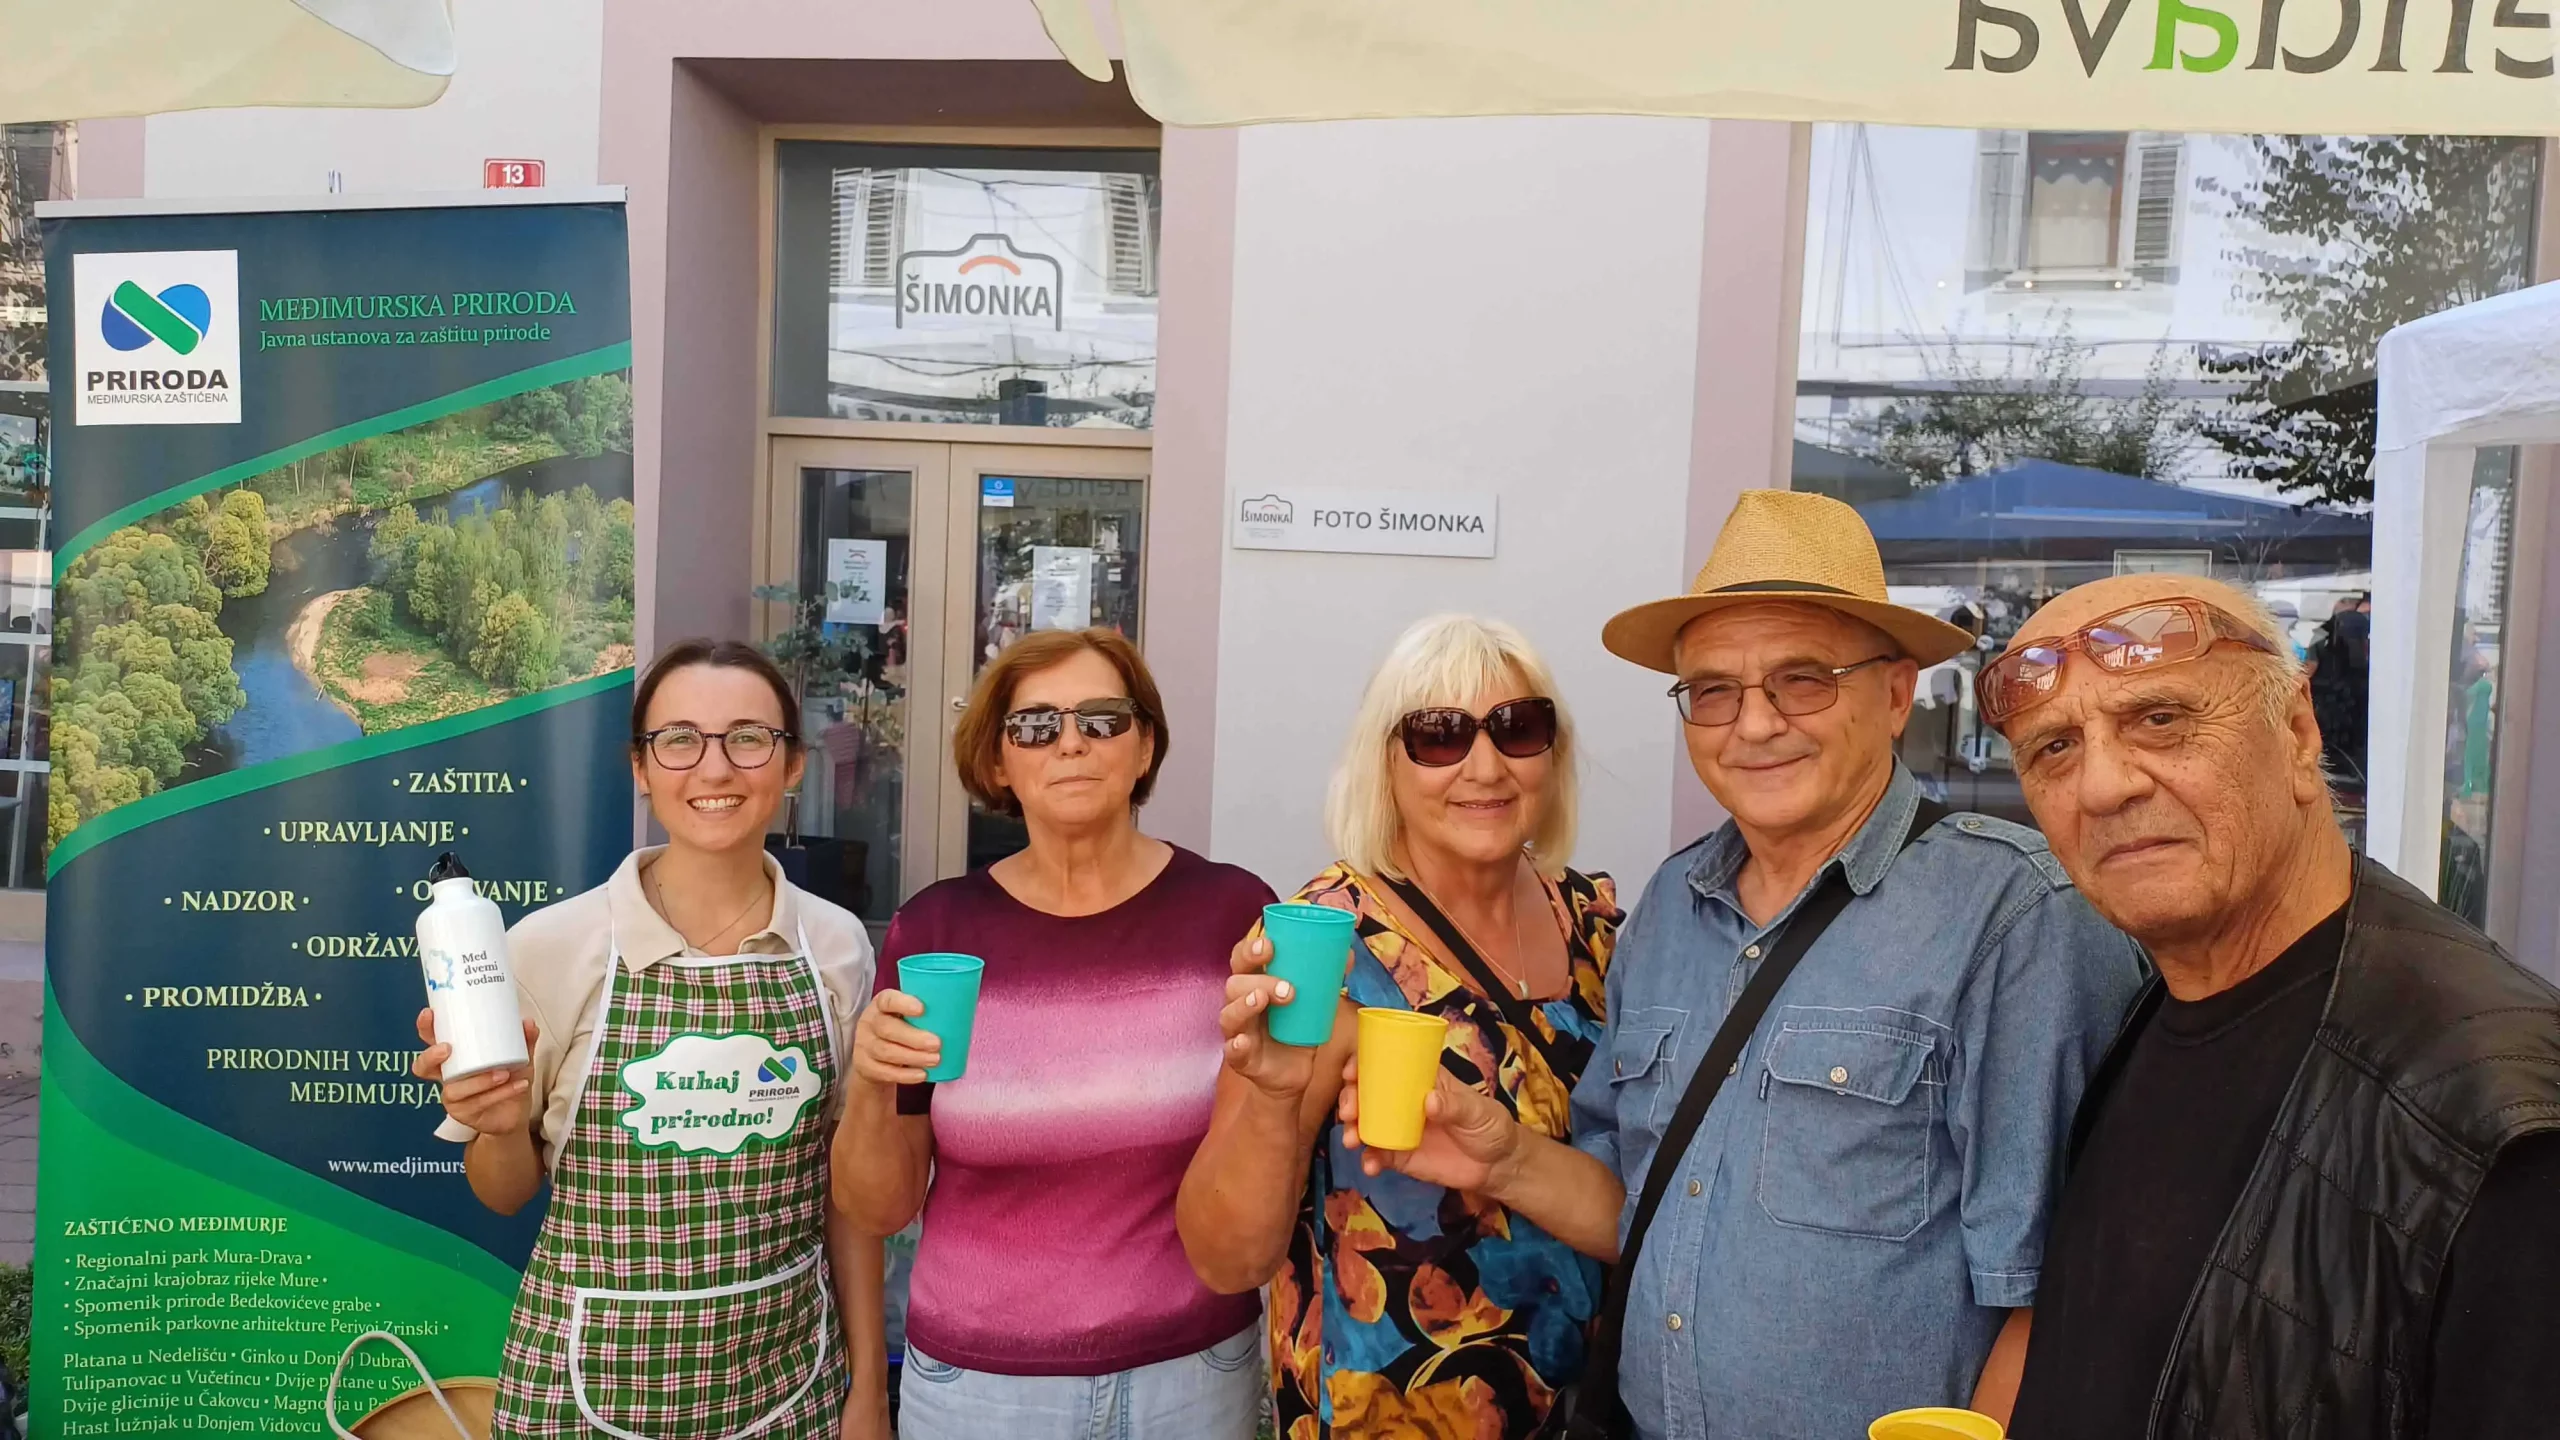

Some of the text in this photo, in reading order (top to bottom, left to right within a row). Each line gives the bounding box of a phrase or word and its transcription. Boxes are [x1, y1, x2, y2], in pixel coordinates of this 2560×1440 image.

[502, 164, 525, 184] 13
[259, 291, 577, 321] MEĐIMURSKA PRIRODA
[905, 273, 1053, 317] ŠIMONKA
[259, 322, 551, 351] Javna ustanova za zaštitu prirode
[87, 369, 229, 391] PRIRODA
[87, 391, 229, 405] MEĐIMURSKA ZAŠTIĆENA
[1313, 507, 1485, 534] FOTO ŠIMONKA
[408, 767, 515, 794] ZAŠTITA
[279, 819, 455, 848] UPRAVLJANJE
[182, 890, 297, 912] NADZOR
[412, 880, 549, 907] OVANJE
[462, 950, 488, 963] Med
[466, 972, 506, 987] vodami
[143, 981, 310, 1008] PROMIDŽBA
[206, 1048, 350, 1072] PRIRODNIH
[655, 1070, 741, 1093] Kuhaj
[749, 1086, 800, 1098] PRIRODA
[290, 1081, 442, 1110] MEĐIMURJA
[651, 1107, 773, 1134] prirodno!
[65, 1216, 288, 1236] ZAŠTIĆENO MEĐIMURJE
[76, 1249, 302, 1272] Regionalni park Mura-Drava
[75, 1271, 319, 1292] Značajni krajobraz rijeke Mure
[74, 1293, 372, 1317] Spomenik prirode Bedekovićeve grabe
[74, 1317, 161, 1339] Spomenik
[165, 1315, 239, 1335] parkovne
[242, 1315, 326, 1333] arhitekture
[383, 1320, 439, 1336] Zrinski
[64, 1353, 127, 1369] Platana
[132, 1356, 142, 1365] u
[149, 1347, 227, 1364] Nedelišću
[241, 1349, 285, 1364] Ginko
[289, 1354, 298, 1364] u
[304, 1350, 354, 1370] Donjj
[62, 1374, 167, 1394] Tulipanovac
[171, 1374, 181, 1385] u
[186, 1369, 261, 1386] Vučetincu
[275, 1372, 315, 1391] Dvije
[378, 1379, 387, 1390] u
[62, 1398, 107, 1416] Dvije
[111, 1394, 180, 1414] glicinije
[184, 1396, 193, 1406] u
[198, 1389, 260, 1409] Čakovcu
[274, 1396, 350, 1414] Magnoija
[354, 1400, 363, 1411] u
[62, 1414, 321, 1436] Hrast lužnjak u Donjem Vidovcu
